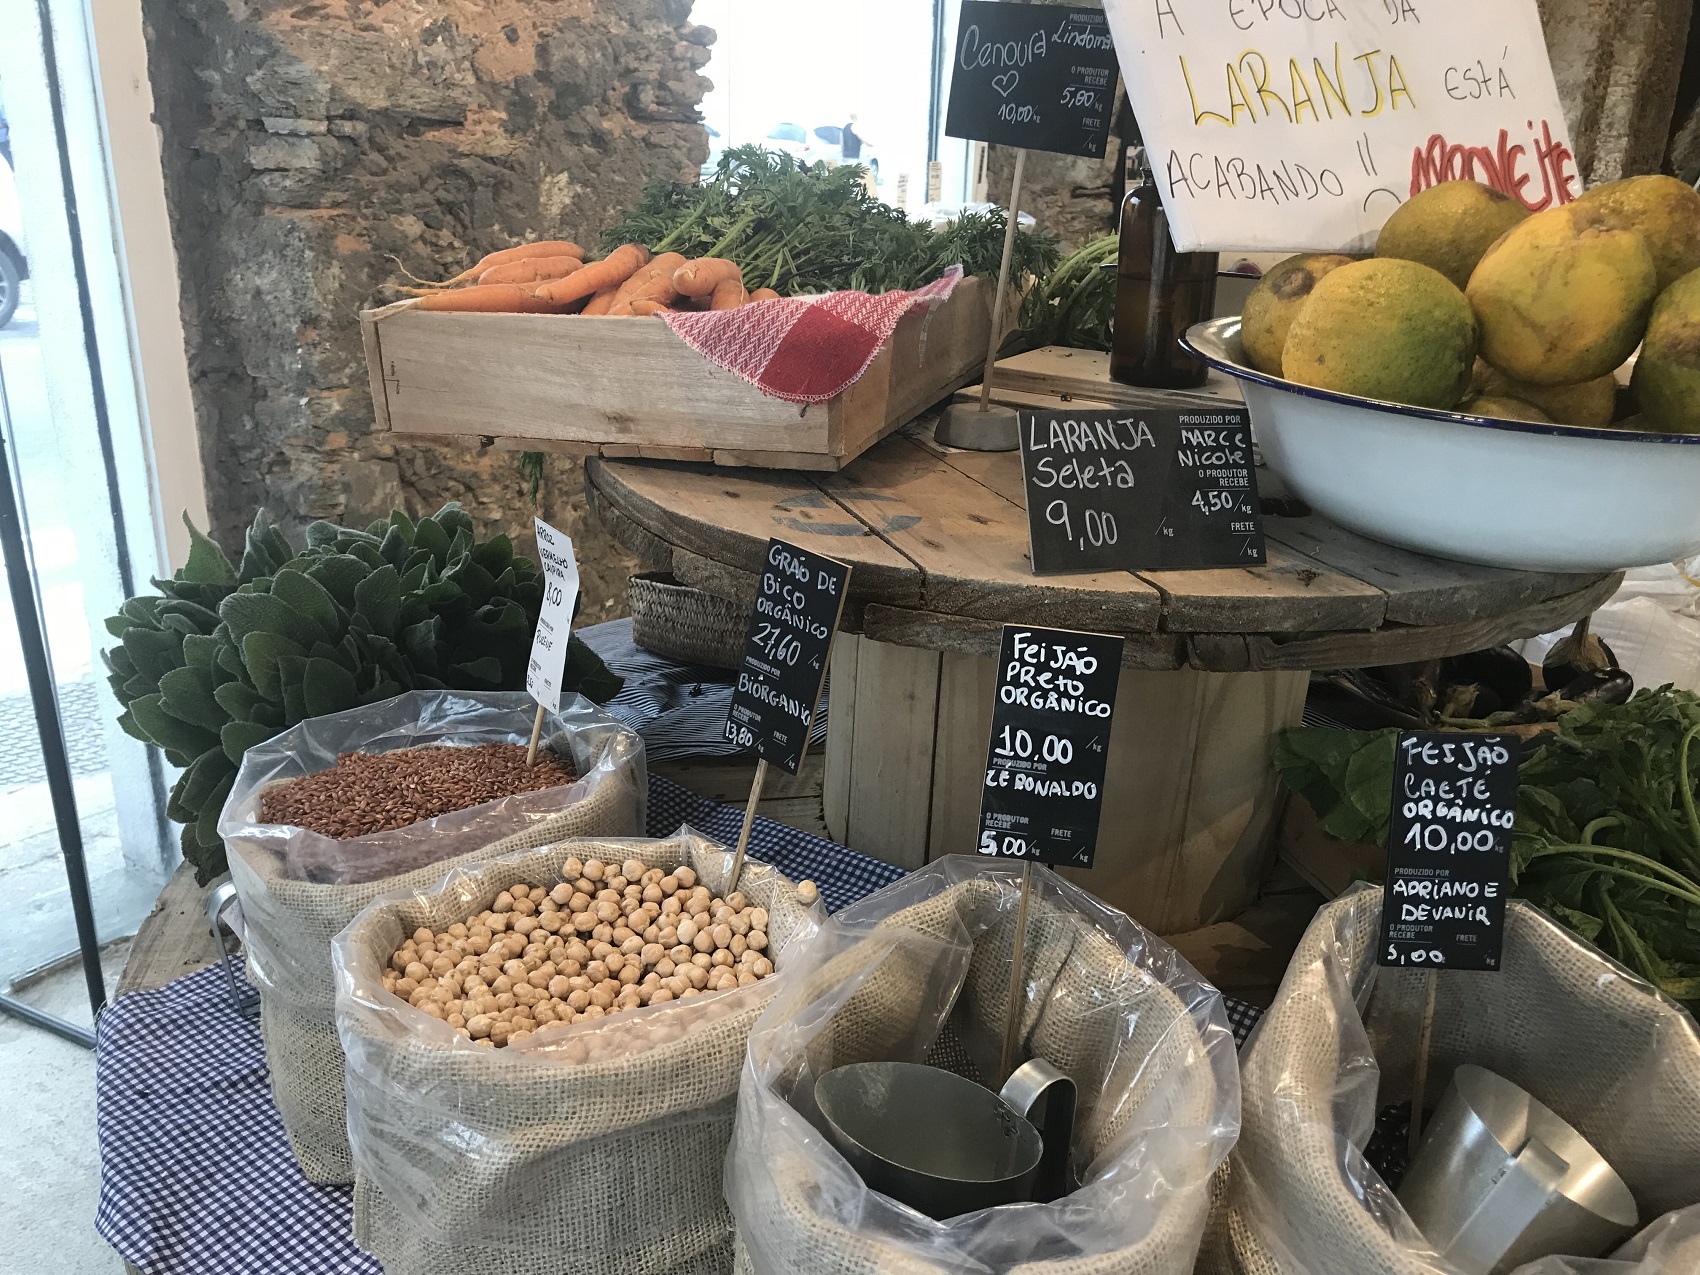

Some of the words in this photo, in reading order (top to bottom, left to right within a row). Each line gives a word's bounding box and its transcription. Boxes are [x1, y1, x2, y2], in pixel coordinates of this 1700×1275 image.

[1070, 14, 1104, 22] PRODUZIDO
[960, 24, 1046, 70] Cenoura
[1076, 68, 1109, 76] PRODUTOR
[1084, 76, 1108, 86] RECEBE
[1179, 42, 1416, 127] LARANJA
[998, 103, 1032, 124] 10,00
[1082, 118, 1100, 127] FRETE
[1167, 149, 1344, 204] ACABANDO
[1179, 416, 1223, 424] PRODUZIDO
[1226, 415, 1241, 423] POR
[1030, 416, 1156, 453] LARANJA
[1032, 456, 1134, 489] Seleta
[1199, 469, 1204, 478] O
[1207, 469, 1248, 478] PRODUTOR
[1219, 478, 1249, 486] RECEBE
[1191, 490, 1232, 515] 4,50
[1046, 500, 1118, 550] 9,00
[1231, 522, 1254, 530] FRETE
[769, 545, 809, 583] GRÃO
[818, 571, 837, 594] DE
[746, 656, 771, 672] PRODUZIDO
[770, 667, 780, 676] POR
[738, 705, 761, 722] PRODUTOR
[726, 720, 752, 747] 13,80
[774, 731, 788, 743] FRETE
[1402, 737, 1509, 772] FEIJÃO
[993, 758, 1032, 769] PRODUZIDO
[1033, 762, 1047, 770] POR
[1014, 773, 1097, 800] RONALDO
[1404, 769, 1491, 800] CAETÉ
[985, 820, 1011, 829] RECEBE
[993, 814, 1029, 824] PRODUTOR
[1051, 828, 1072, 837] FRETE
[1404, 823, 1494, 854] 10,00
[979, 830, 1027, 856] 5,00
[1394, 868, 1434, 876] PRODUZIDO
[1435, 869, 1450, 877] POR
[1484, 882, 1499, 897] E
[1456, 934, 1478, 942] FRETE
